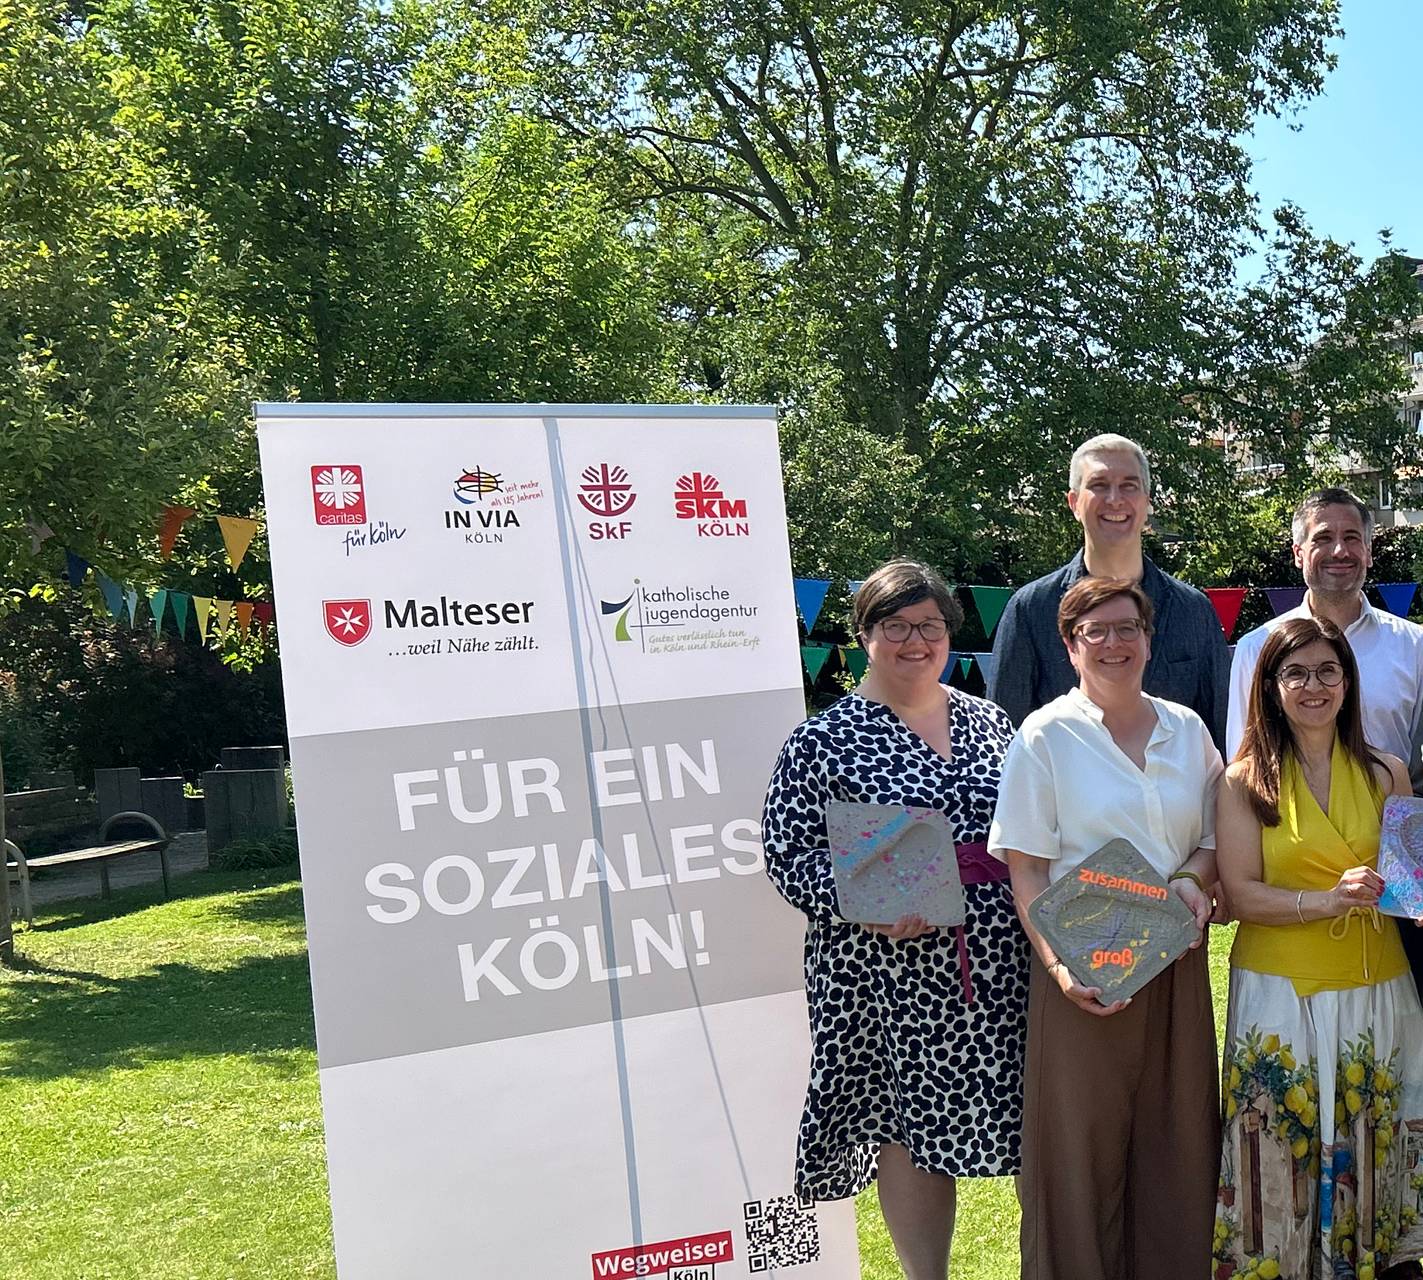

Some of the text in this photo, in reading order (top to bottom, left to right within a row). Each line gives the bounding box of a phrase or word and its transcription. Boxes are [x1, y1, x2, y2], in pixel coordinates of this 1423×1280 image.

[676, 500, 747, 518] SKM
[320, 512, 363, 525] caritas
[445, 510, 520, 528] IN VIA
[589, 522, 632, 540] SkF
[698, 520, 749, 536] KÖLN
[342, 530, 366, 556] für
[465, 533, 502, 543] KÖLN
[642, 585, 730, 603] katholische
[384, 596, 534, 628] Malteser
[645, 604, 758, 624] jugendagentur
[448, 639, 490, 654] Nähe
[494, 636, 538, 652] zählt.
[648, 634, 674, 644] Gutes
[676, 629, 726, 641] verlässlich
[650, 636, 760, 654] in Köln und Rhein-Erft
[393, 739, 721, 831] FÜR EIN
[364, 818, 765, 925] SOZIALES
[1078, 868, 1168, 900] zusammen
[457, 910, 711, 1002] KÖLN!
[1092, 948, 1133, 968] groß
[595, 1240, 728, 1276] Wegweiser
[673, 1268, 709, 1280] Köln
